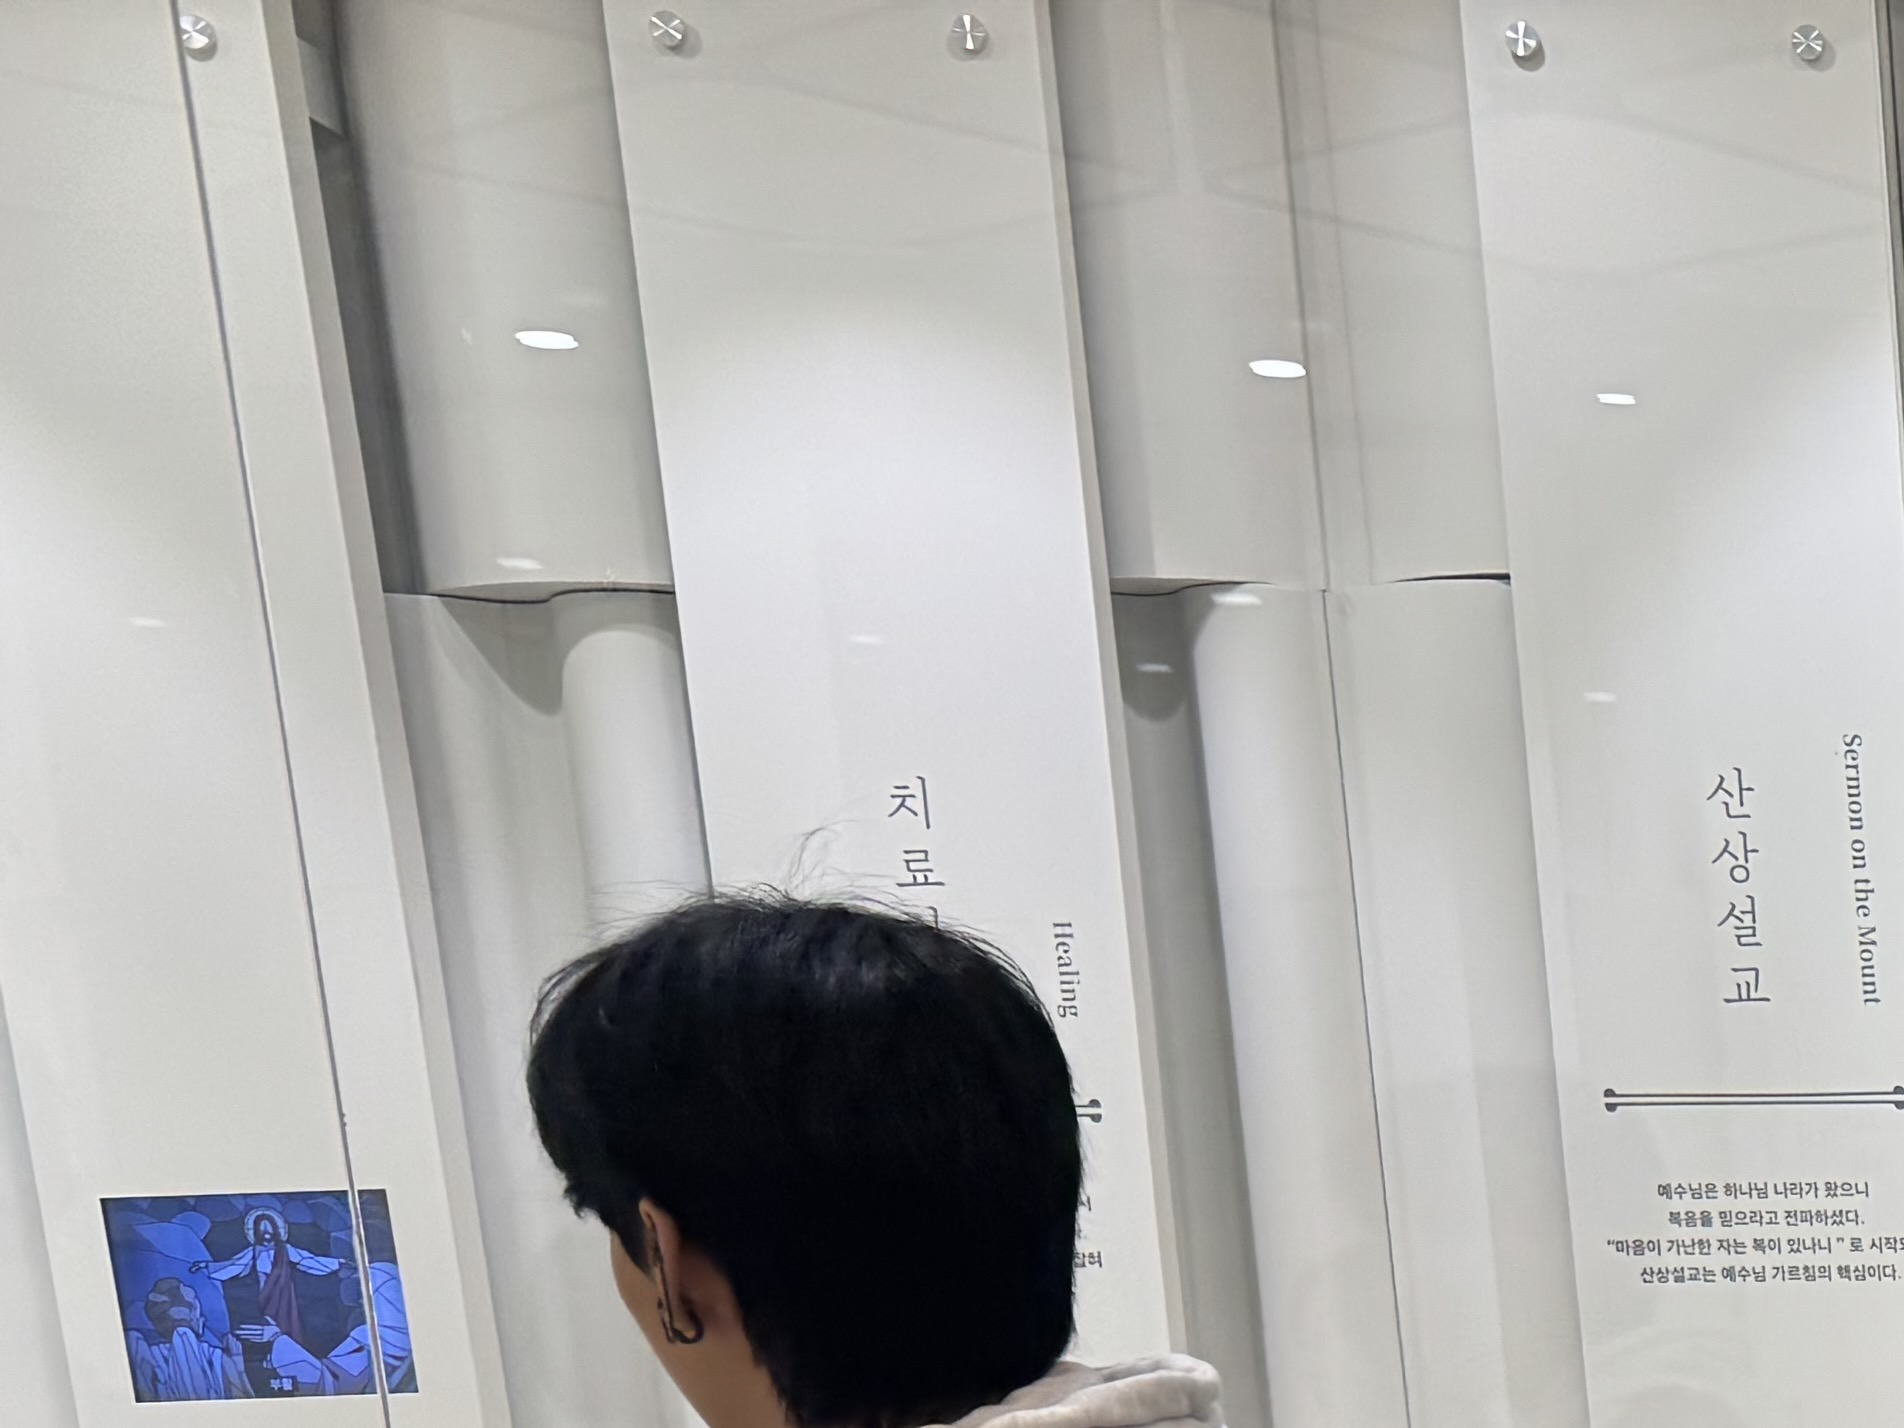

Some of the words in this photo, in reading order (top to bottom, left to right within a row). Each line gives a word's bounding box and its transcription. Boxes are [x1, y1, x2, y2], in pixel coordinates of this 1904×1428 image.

[1842, 734, 1864, 831] Sermon
[1850, 838, 1867, 870] on
[1706, 766, 1772, 1004] 산상설교
[1853, 878, 1875, 918] the
[1052, 921, 1081, 1019] Healing
[1857, 926, 1882, 1005] Mount
[1657, 1182, 1719, 1201] 예수님은
[1722, 1181, 1769, 1200] 하나님
[1773, 1181, 1819, 1200] 나라가
[1824, 1181, 1870, 1199] 왔으니
[1667, 1209, 1714, 1228] 복음을
[1718, 1209, 1781, 1228] 믿으라고
[1783, 1209, 1865, 1227] 전파하셨다.
[1666, 1237, 1712, 1256] 가난한
[1716, 1238, 1748, 1256] 자는
[1751, 1236, 1782, 1255] 복이
[1640, 1266, 1717, 1284] 산상설교는
[1720, 1265, 1767, 1283] 예수님
[1771, 1264, 1832, 1282] 가르침의
[1836, 1263, 1902, 1282] 핵심이다.
